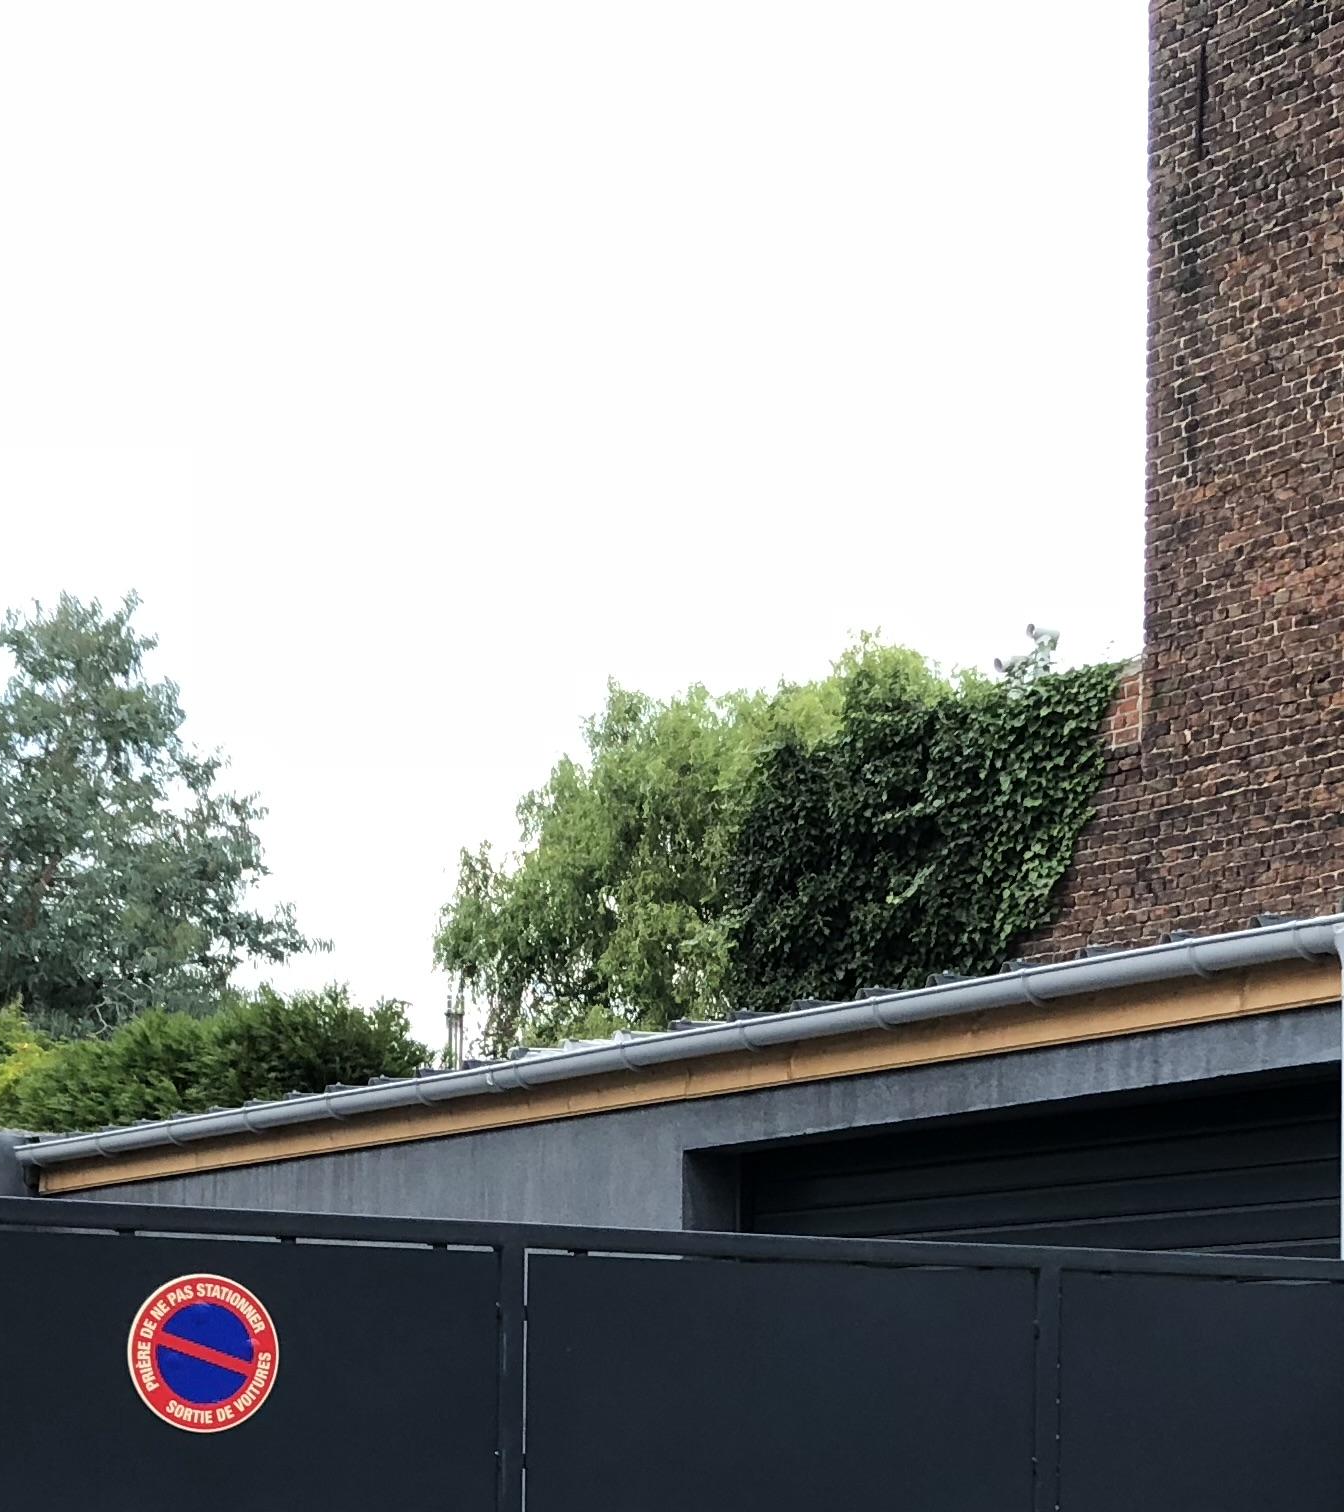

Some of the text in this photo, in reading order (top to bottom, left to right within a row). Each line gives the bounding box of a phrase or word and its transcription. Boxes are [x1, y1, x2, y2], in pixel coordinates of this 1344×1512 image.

[136, 1283, 266, 1392] PRIÈRE DE NE PAS STATIONNER
[166, 1352, 272, 1424] SORTIE DE VOITURES
